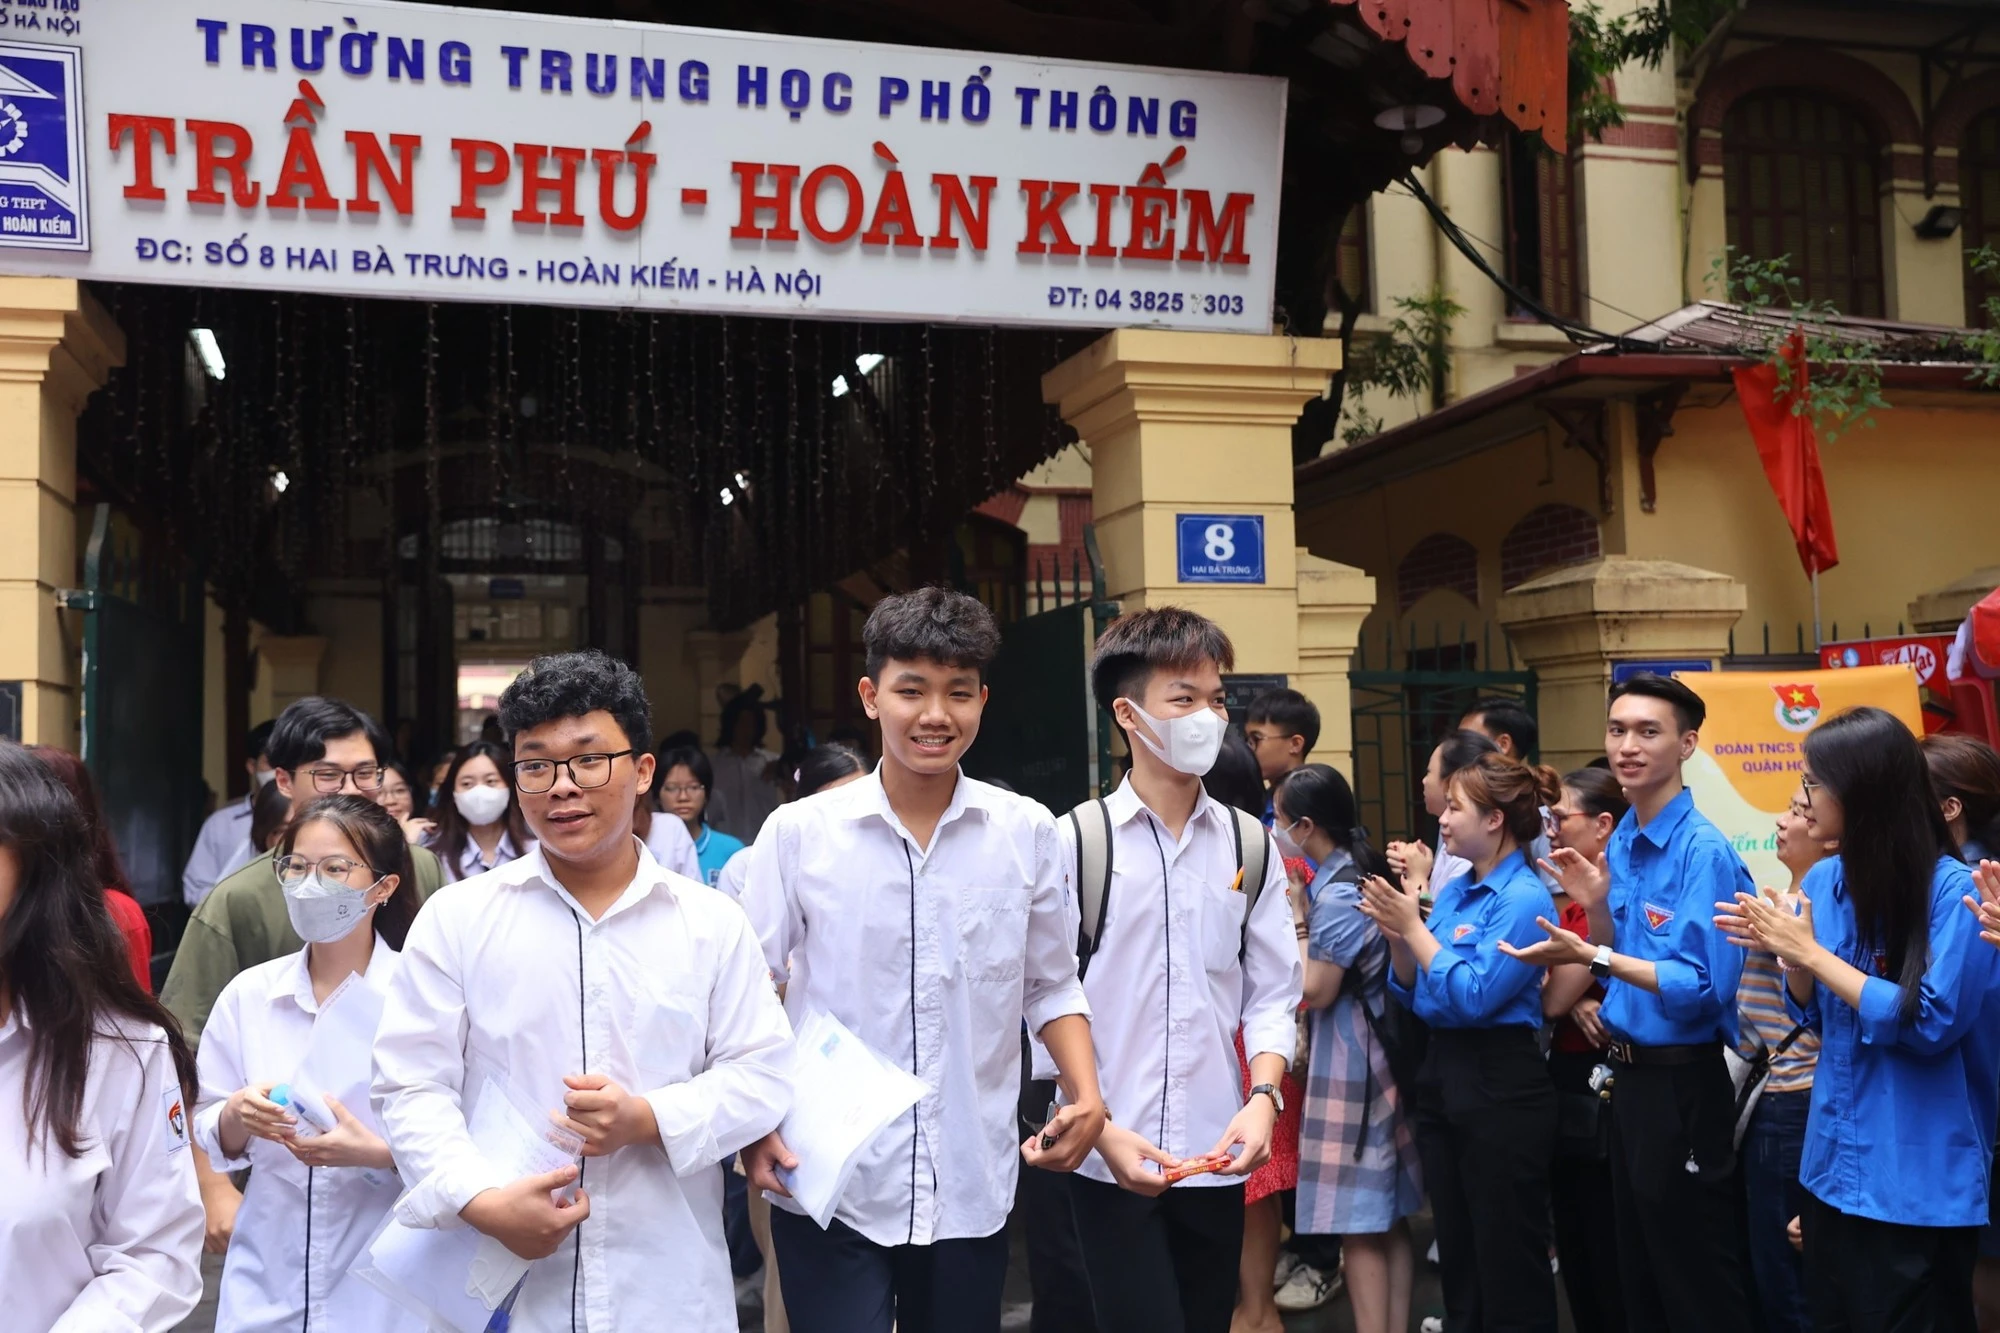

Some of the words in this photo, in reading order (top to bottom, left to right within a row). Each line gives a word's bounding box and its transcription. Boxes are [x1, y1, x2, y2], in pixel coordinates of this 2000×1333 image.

[15, 11, 41, 29] HÀ
[47, 16, 80, 36] NỘI
[196, 17, 472, 83] TRƯỜNG
[501, 45, 709, 102] TRUNG
[737, 64, 853, 121] HỌC
[879, 65, 992, 122] PHỔ
[1015, 85, 1198, 138] THÔNG
[108, 79, 422, 216] TRẦN
[450, 120, 657, 232] PHÚ
[681, 188, 707, 205] -
[730, 141, 998, 251] HOÀN
[1016, 145, 1255, 265] KIẾM
[11, 197, 47, 210] THPT
[40, 214, 71, 235] KIẾM
[136, 238, 192, 263] ĐC:
[204, 233, 249, 265] SỐ
[259, 246, 275, 268] 8
[286, 247, 337, 272] HAI
[352, 245, 394, 275] BÀ
[404, 253, 509, 280] TRƯNG
[537, 256, 620, 286] HOÀN
[631, 257, 699, 290] KIẾM
[726, 265, 765, 293] HÀ
[775, 268, 821, 300] NỘI
[1048, 286, 1087, 308] ĐT:
[1095, 289, 1121, 309] 04
[1130, 290, 1183, 313] 3825
[1191, 293, 1244, 316] 303
[1204, 523, 1236, 562] 8
[1191, 565, 1207, 574] HAI
[1222, 565, 1251, 574] TRƯNG
[1714, 741, 1754, 755] ĐOÀN
[1757, 742, 1795, 753] TNCS
[1742, 759, 1783, 773] QUẬN
